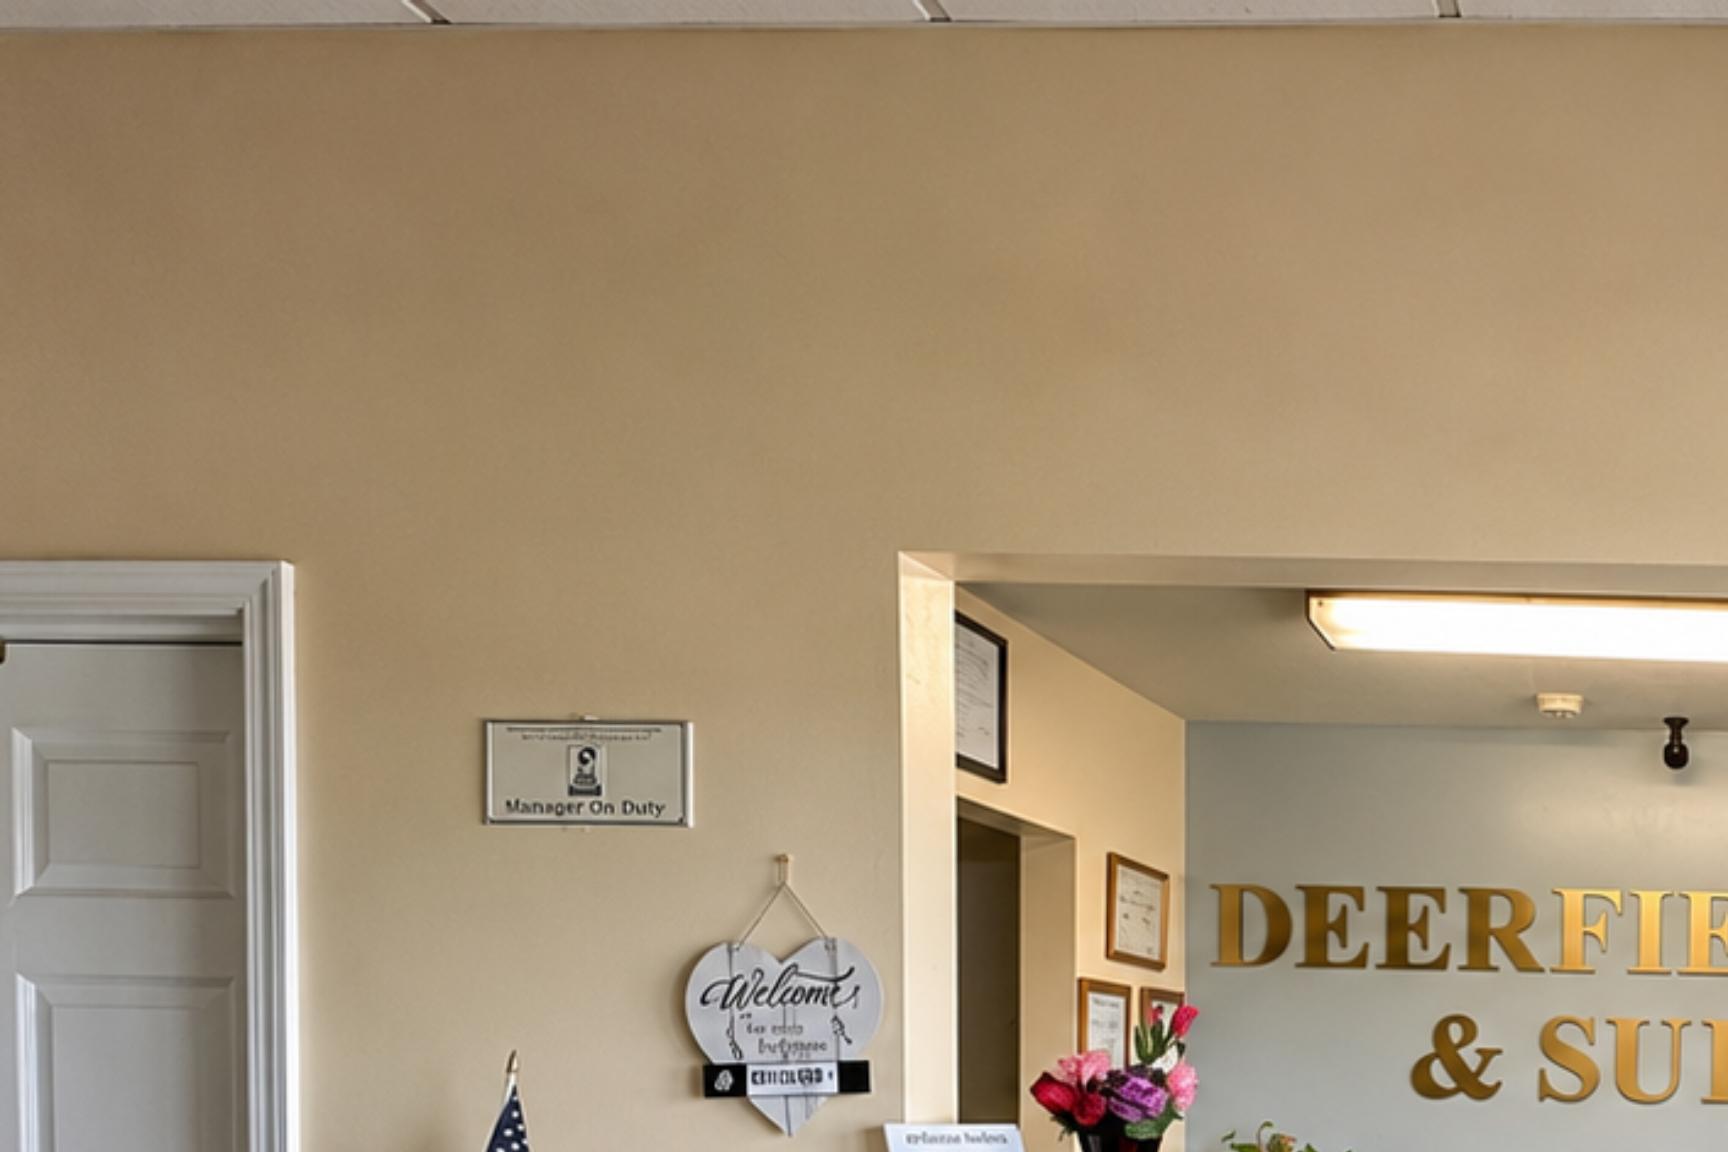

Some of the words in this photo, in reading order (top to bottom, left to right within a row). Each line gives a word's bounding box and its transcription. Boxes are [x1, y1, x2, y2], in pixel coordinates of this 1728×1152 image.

[505, 799, 585, 817] Manager
[589, 800, 615, 816] On
[621, 800, 666, 818] Duty
[700, 962, 860, 1011] Welcome
[1409, 1012, 1503, 1102] &
